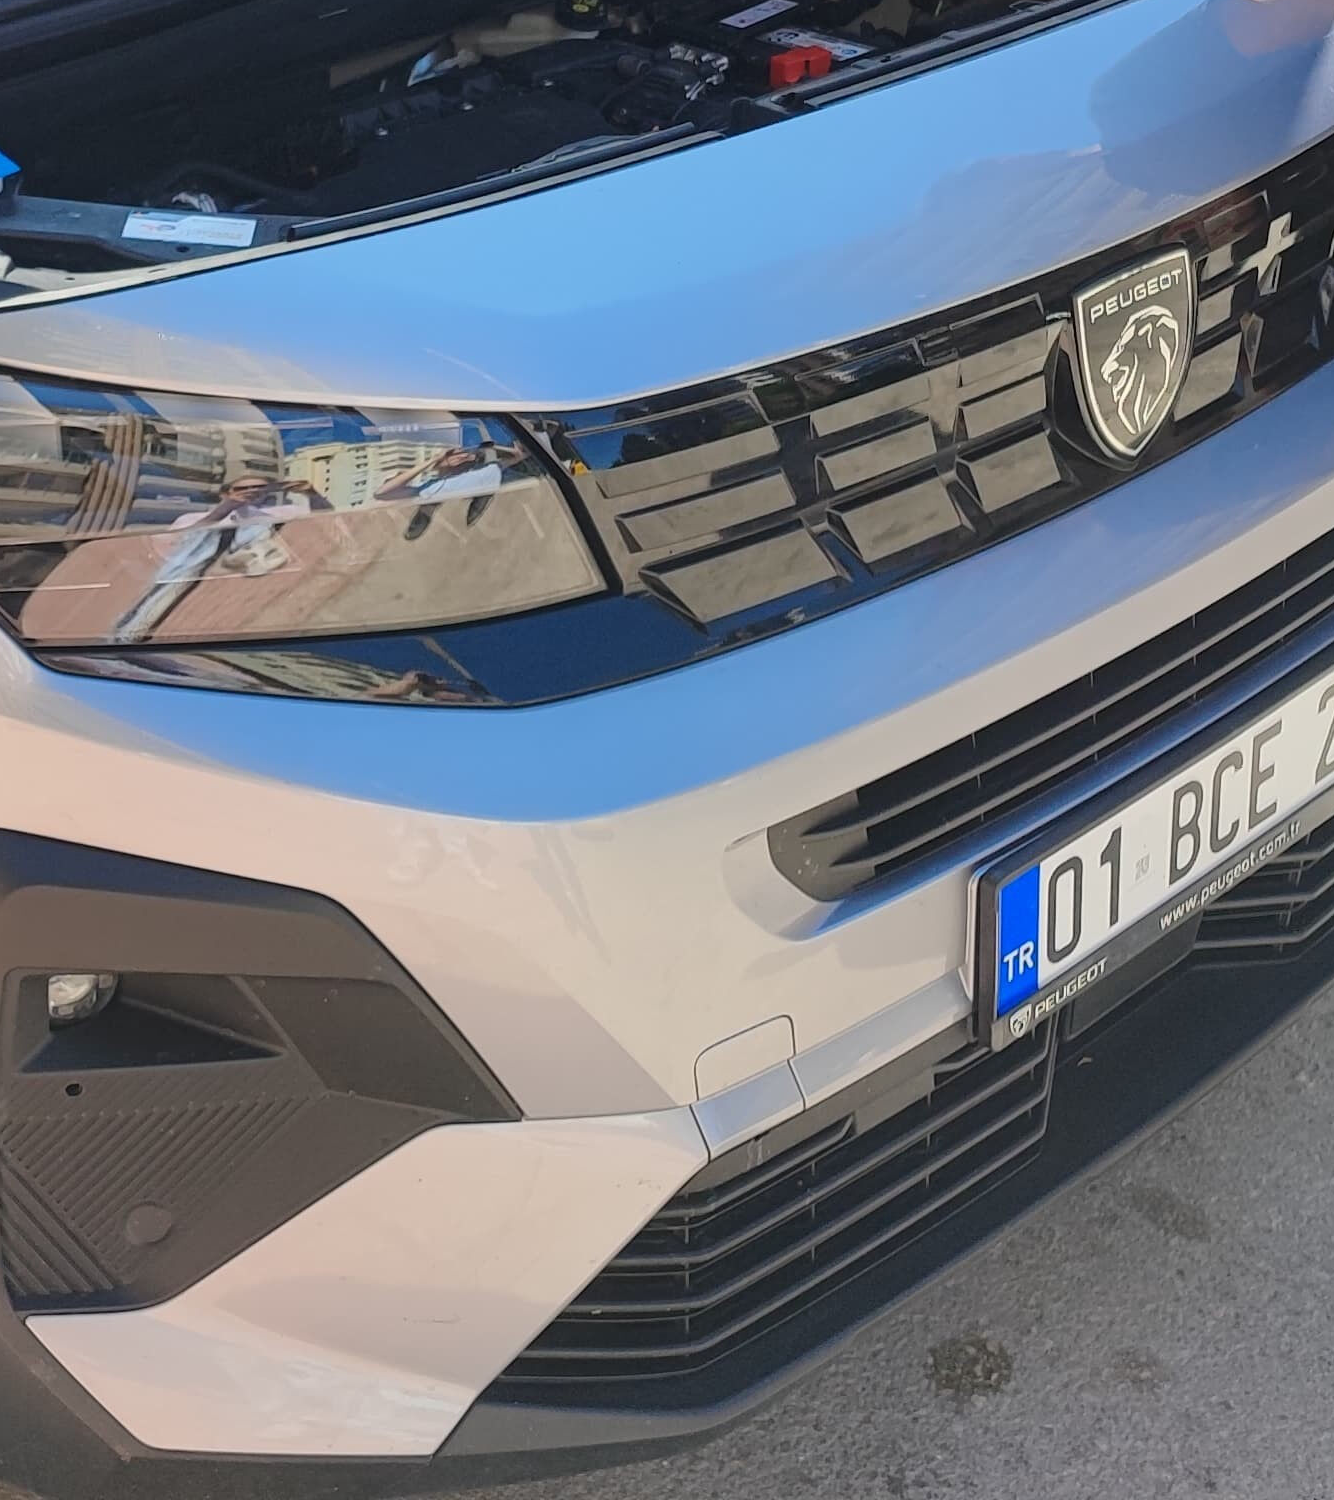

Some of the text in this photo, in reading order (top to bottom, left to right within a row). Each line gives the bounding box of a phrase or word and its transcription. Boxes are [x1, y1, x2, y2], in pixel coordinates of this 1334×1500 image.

[1090, 268, 1183, 324] PEUGEOT
[1046, 826, 1122, 965] 01
[1168, 718, 1283, 886] BCE
[1003, 940, 1035, 983] TR
[1034, 956, 1108, 1020] PEUGEOT
[1158, 820, 1302, 932] www.peugeot.com.tr
